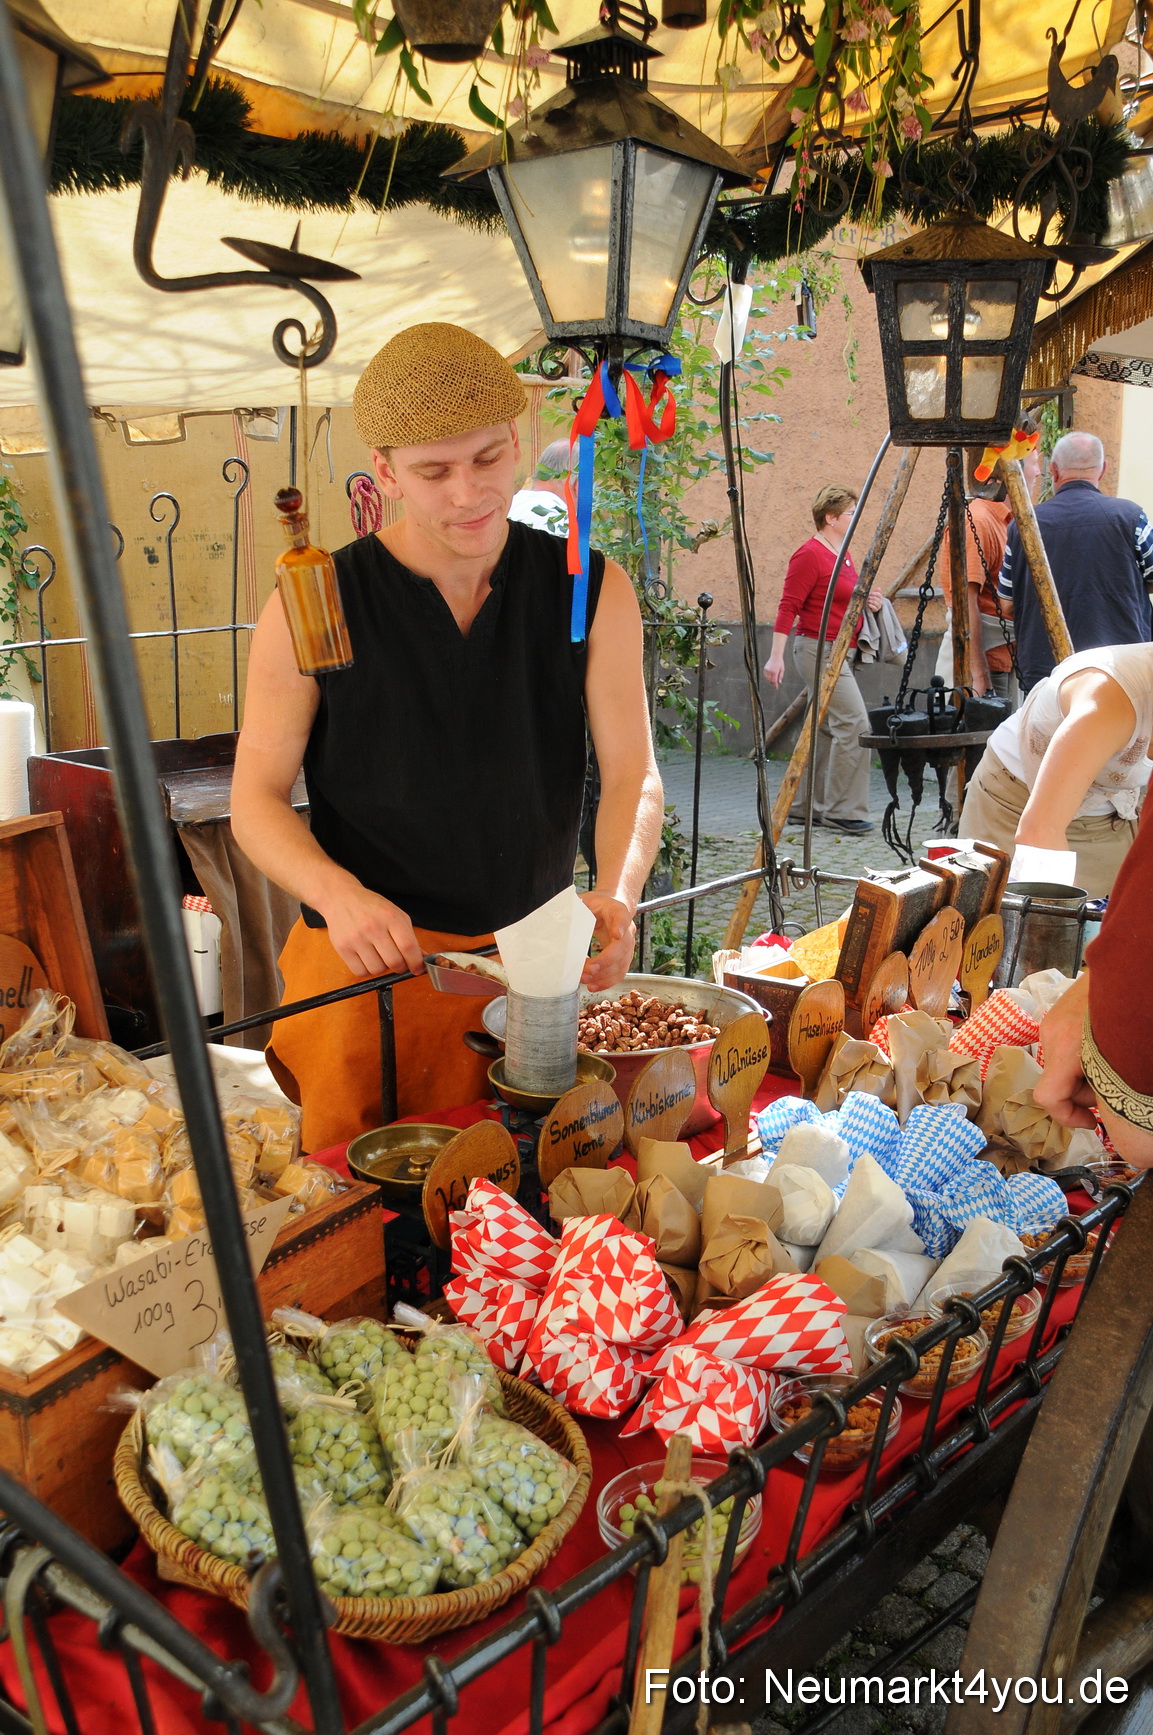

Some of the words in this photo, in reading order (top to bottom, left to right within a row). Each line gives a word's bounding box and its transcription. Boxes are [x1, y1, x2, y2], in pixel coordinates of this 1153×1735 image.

[798, 1012, 844, 1045] Haselnüsse
[715, 1045, 768, 1087] Walnüsse
[549, 1099, 620, 1144] Sonnenblumen
[630, 1083, 692, 1128] Kürbiskerne
[573, 1133, 605, 1161] Kerne
[134, 1302, 175, 1334] 100g
